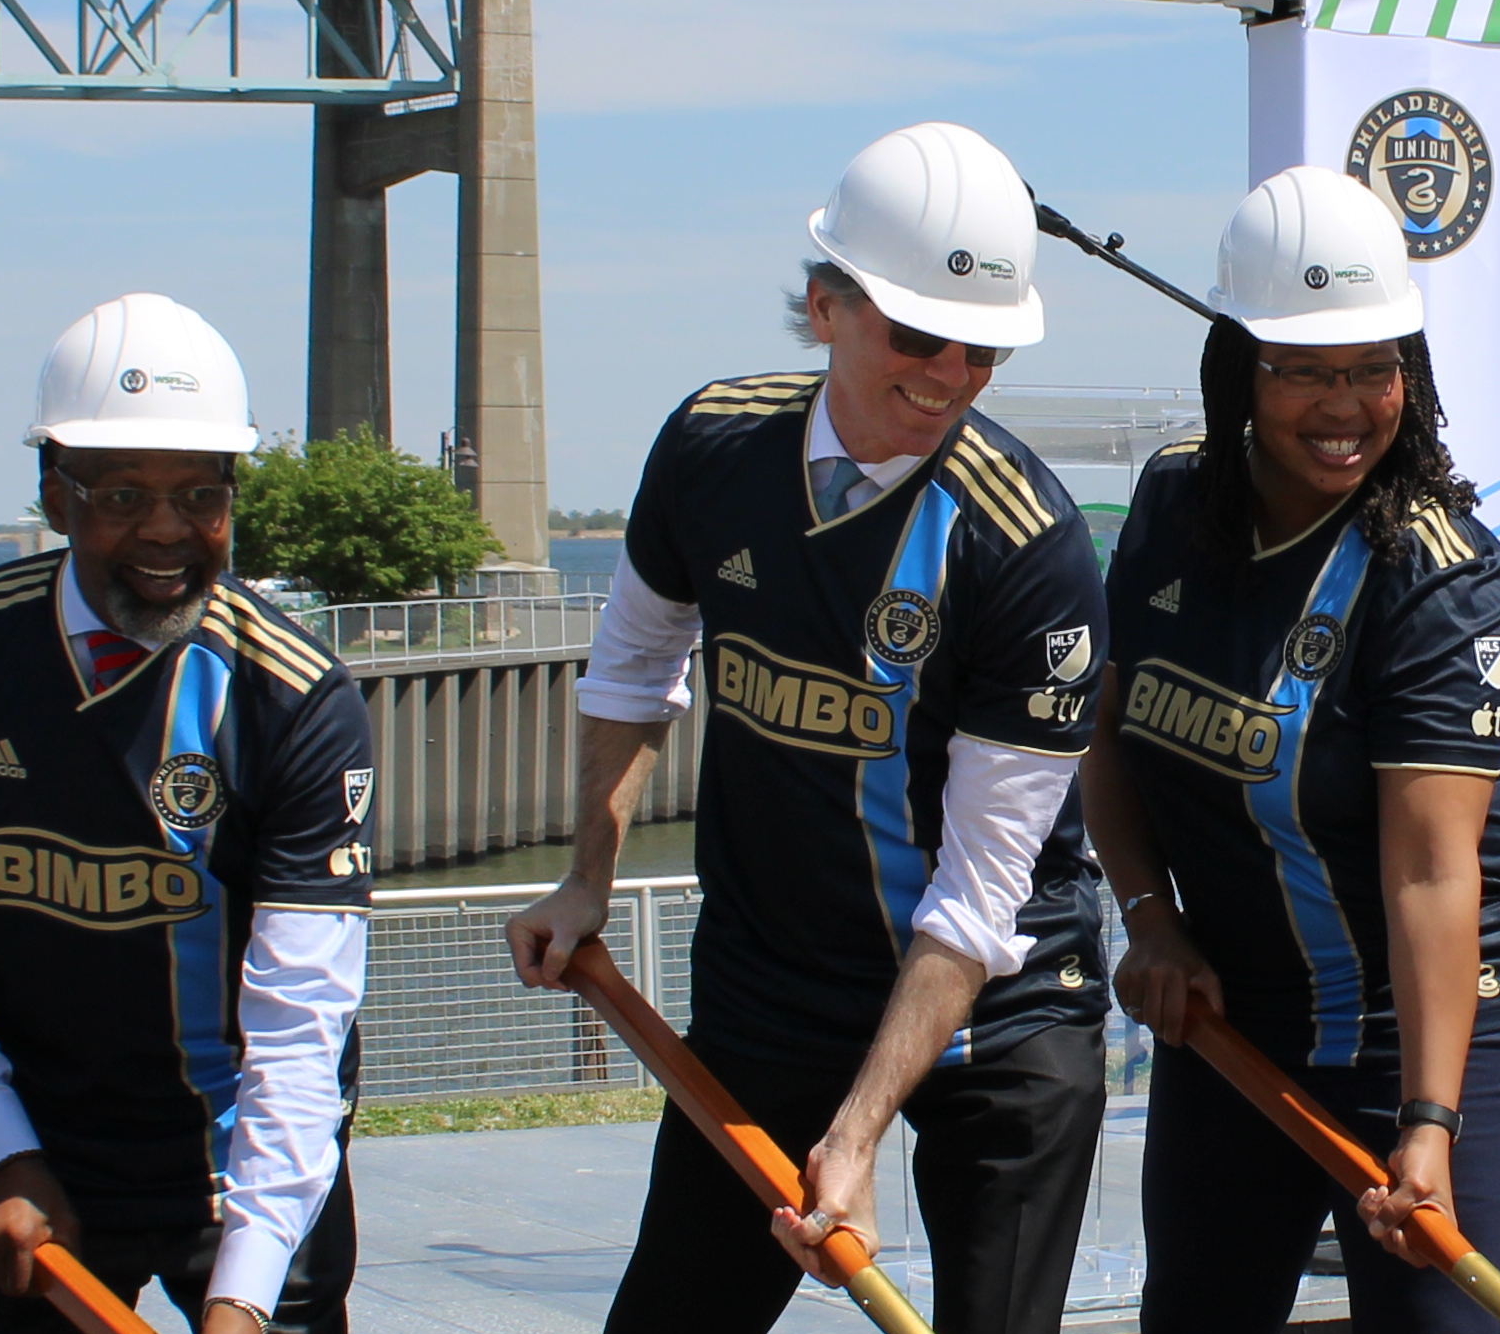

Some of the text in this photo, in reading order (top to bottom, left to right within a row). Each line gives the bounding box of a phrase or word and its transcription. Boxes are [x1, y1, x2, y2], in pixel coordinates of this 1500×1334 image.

[1351, 95, 1488, 172] PHILADELPHIA
[1394, 139, 1449, 162] UNION
[717, 566, 758, 590] adidas
[871, 592, 938, 634] PHILADELPHIA
[893, 608, 921, 624] UNION
[1050, 633, 1076, 648] MLS
[1479, 641, 1500, 653] MLS
[716, 645, 893, 744] BIMBO
[1057, 692, 1086, 723] tv
[1126, 669, 1280, 768] BIMBO
[348, 773, 369, 788] MLS
